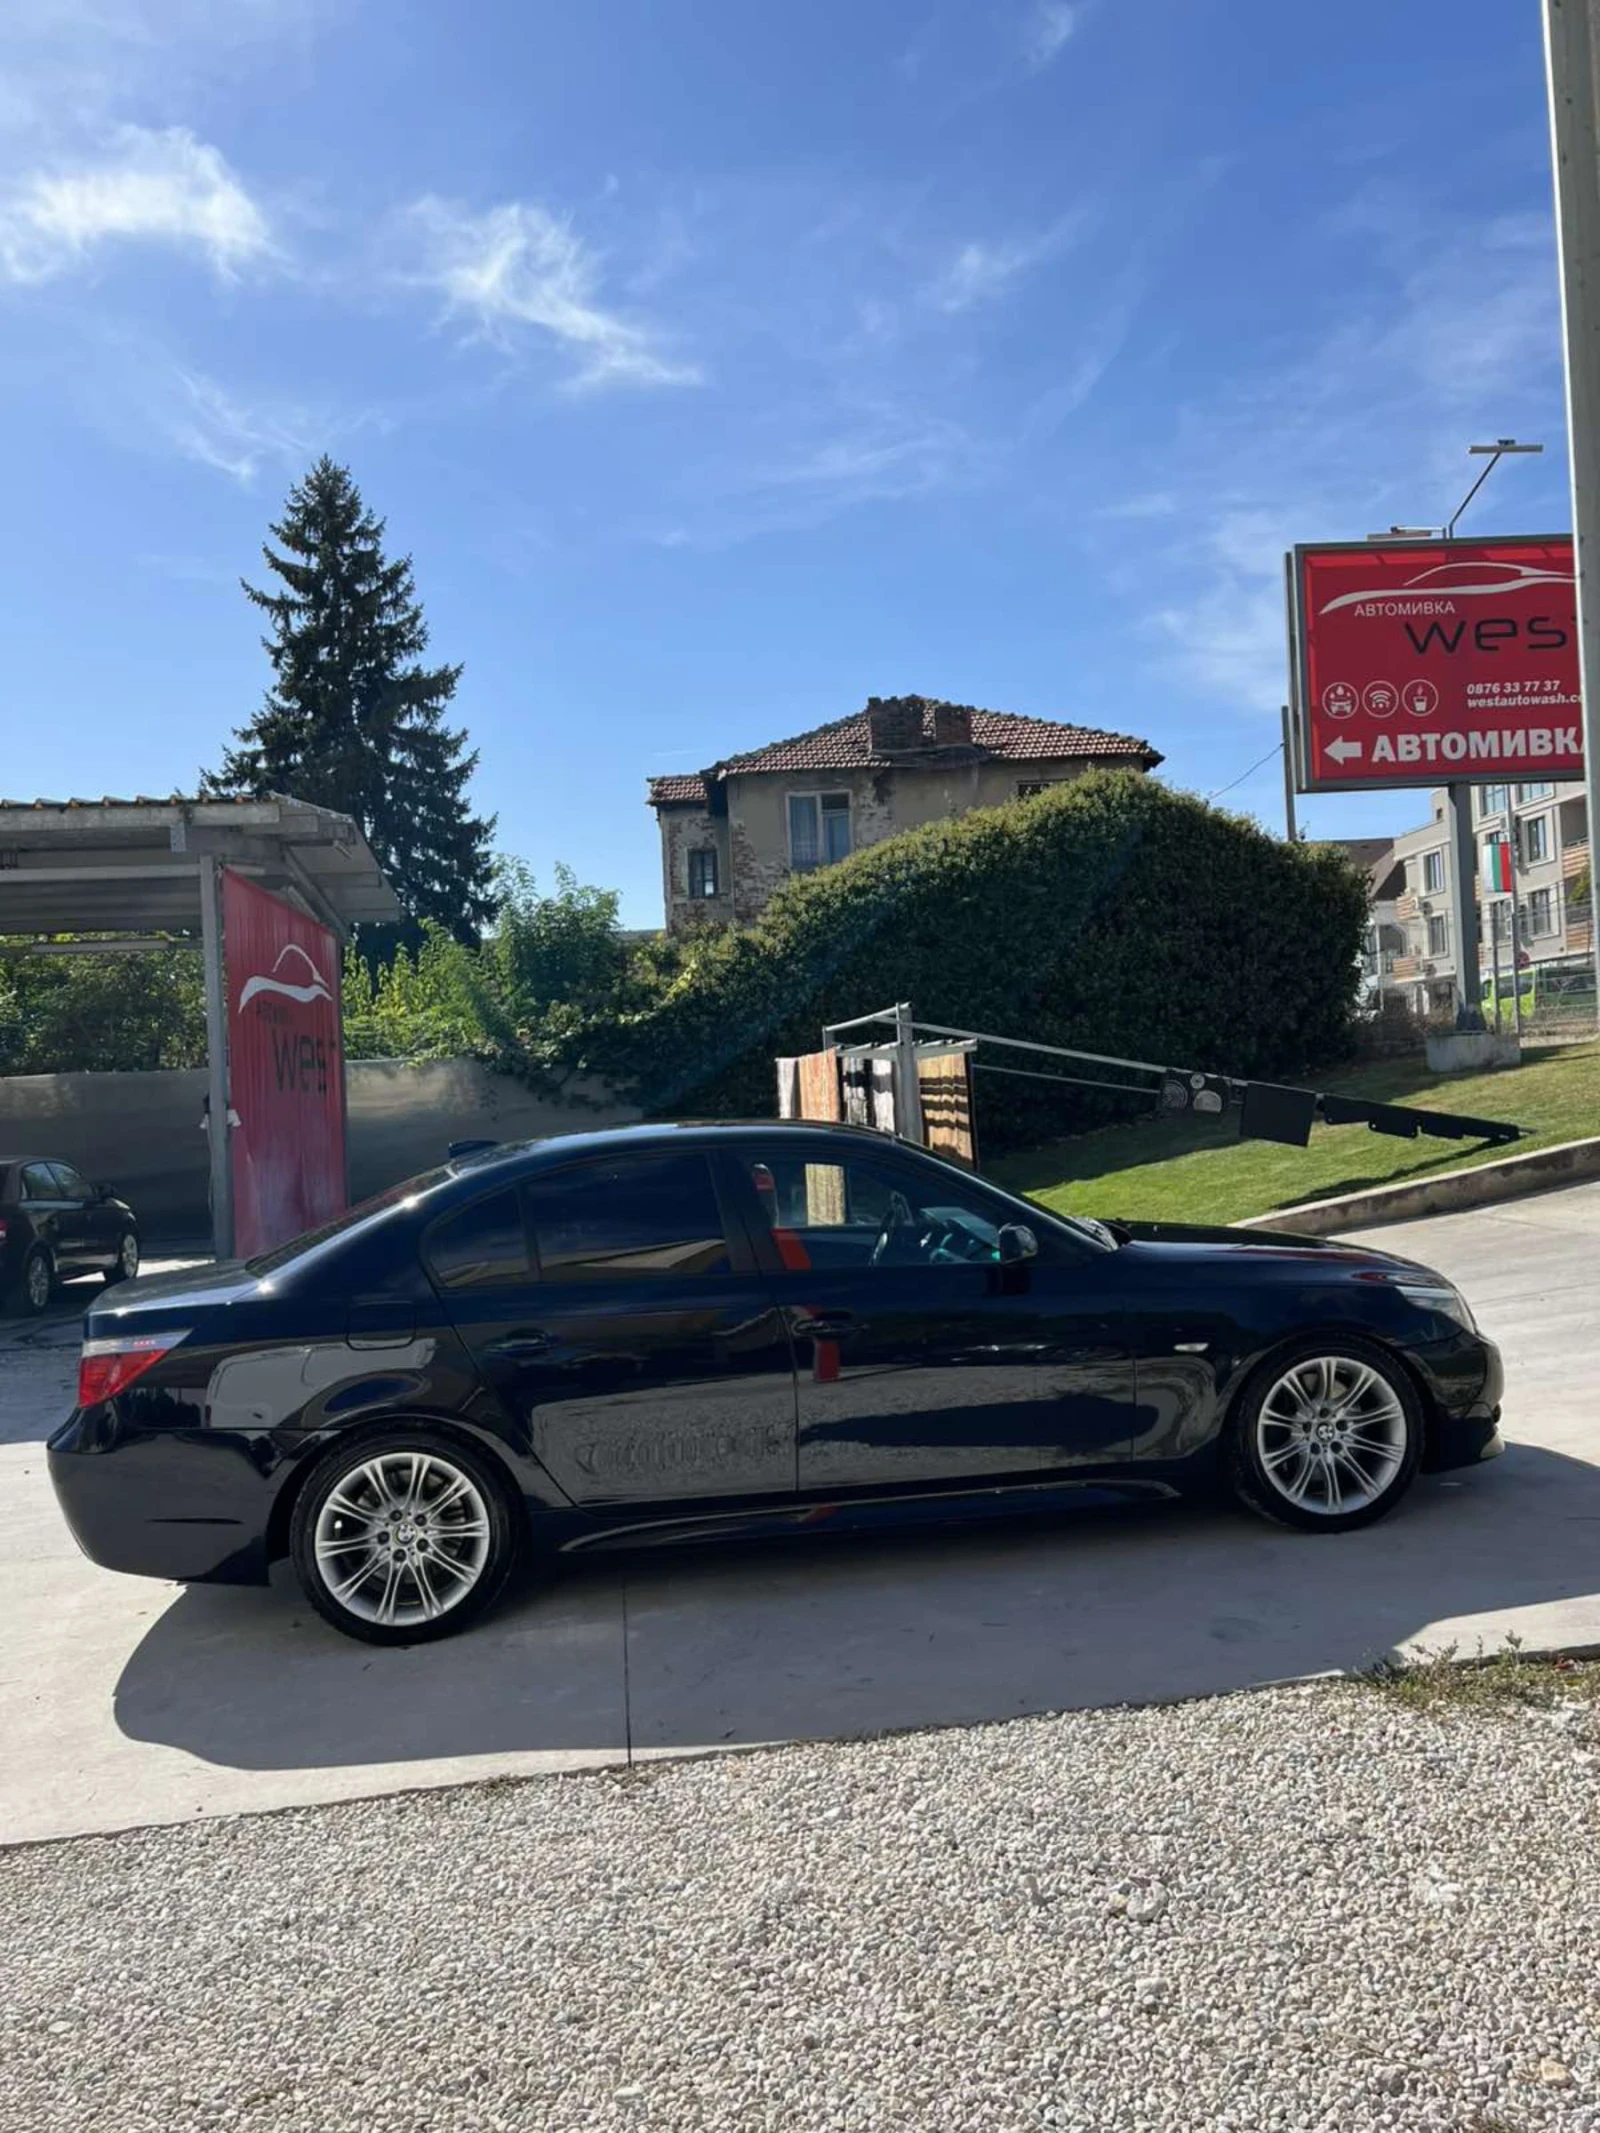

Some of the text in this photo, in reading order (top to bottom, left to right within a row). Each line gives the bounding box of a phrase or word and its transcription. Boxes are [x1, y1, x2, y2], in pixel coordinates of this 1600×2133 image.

[1354, 601, 1456, 617] АВТОМИВКА
[1404, 616, 1578, 655] wes
[1467, 680, 1560, 694] 0876 33 77 37
[1371, 726, 1584, 763] АВТОМИВК
